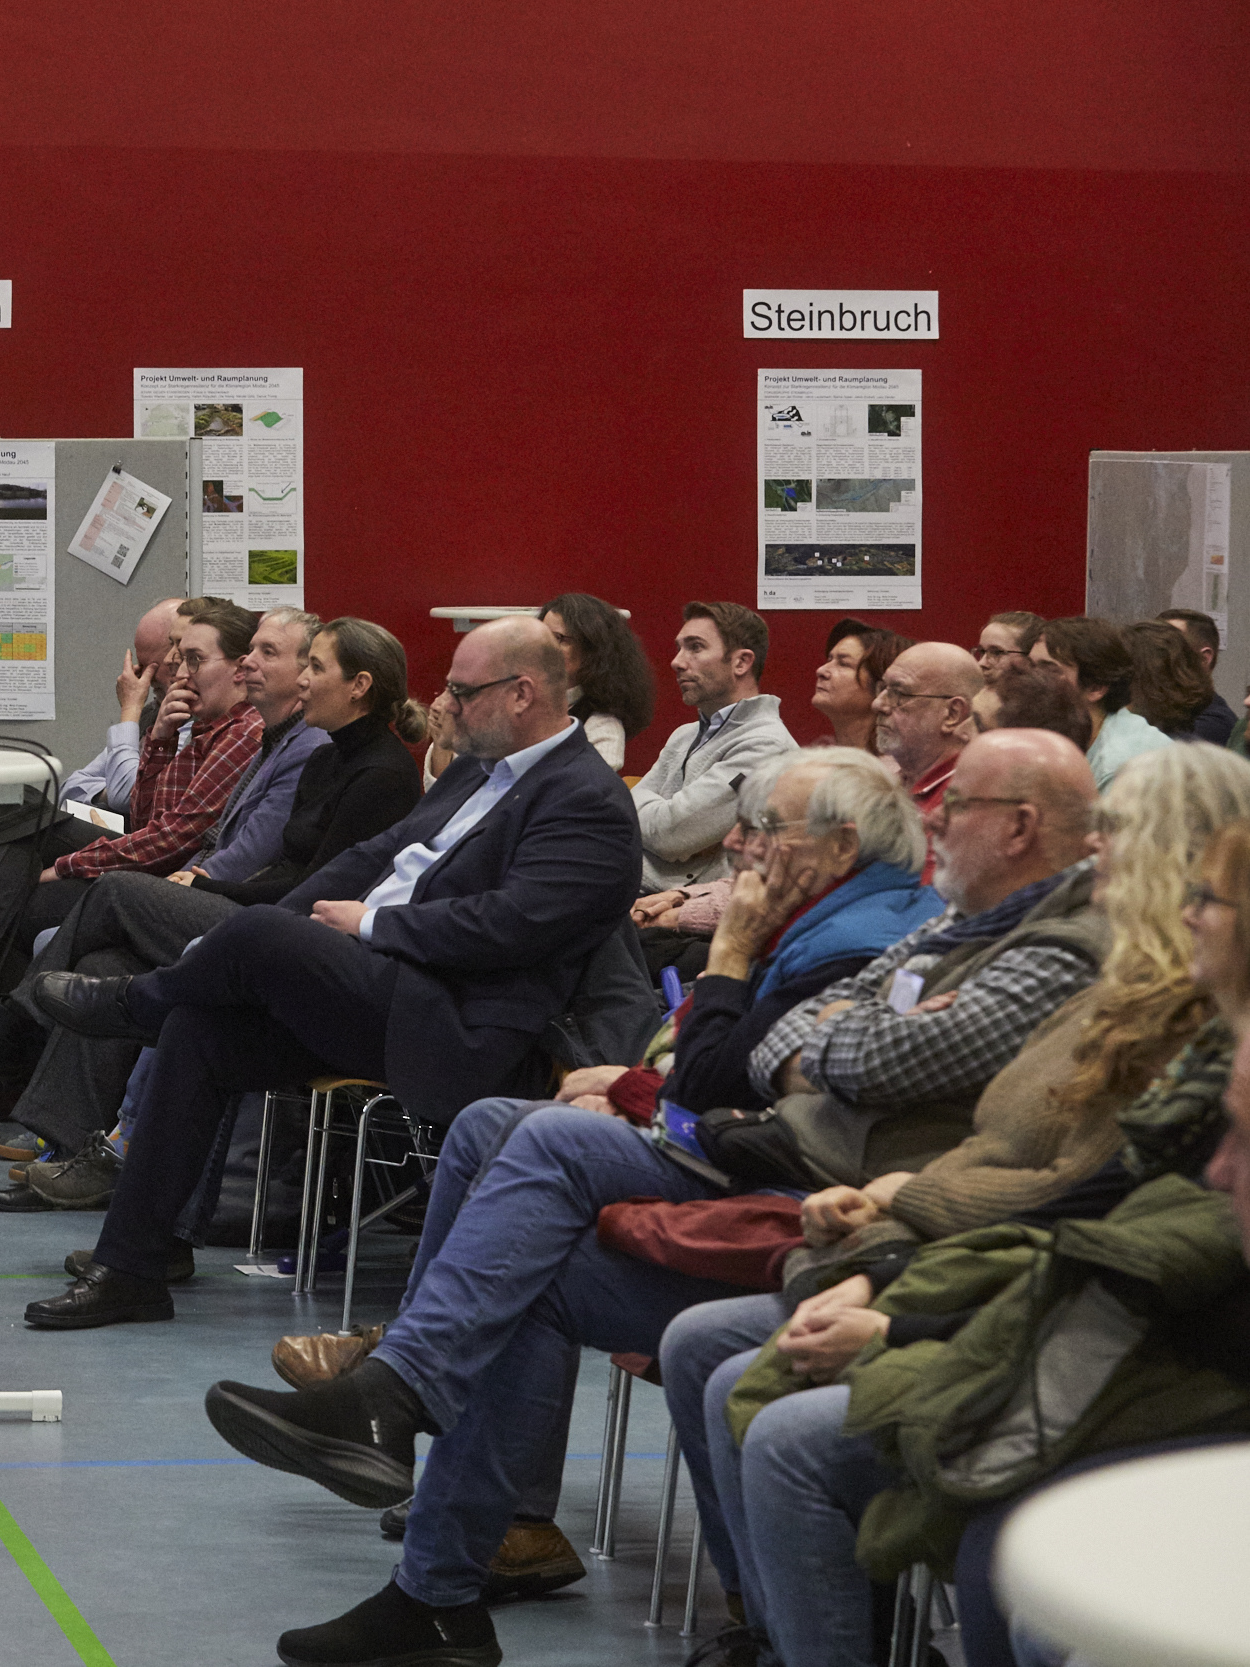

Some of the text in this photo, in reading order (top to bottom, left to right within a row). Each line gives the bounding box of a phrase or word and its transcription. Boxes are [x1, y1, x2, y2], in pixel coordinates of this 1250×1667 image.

[750, 301, 931, 332] Steinbruch
[141, 375, 167, 383] Projekt
[218, 375, 268, 383] Raumplanung
[764, 376, 790, 384] Projekt
[838, 376, 888, 384] Raumplanung
